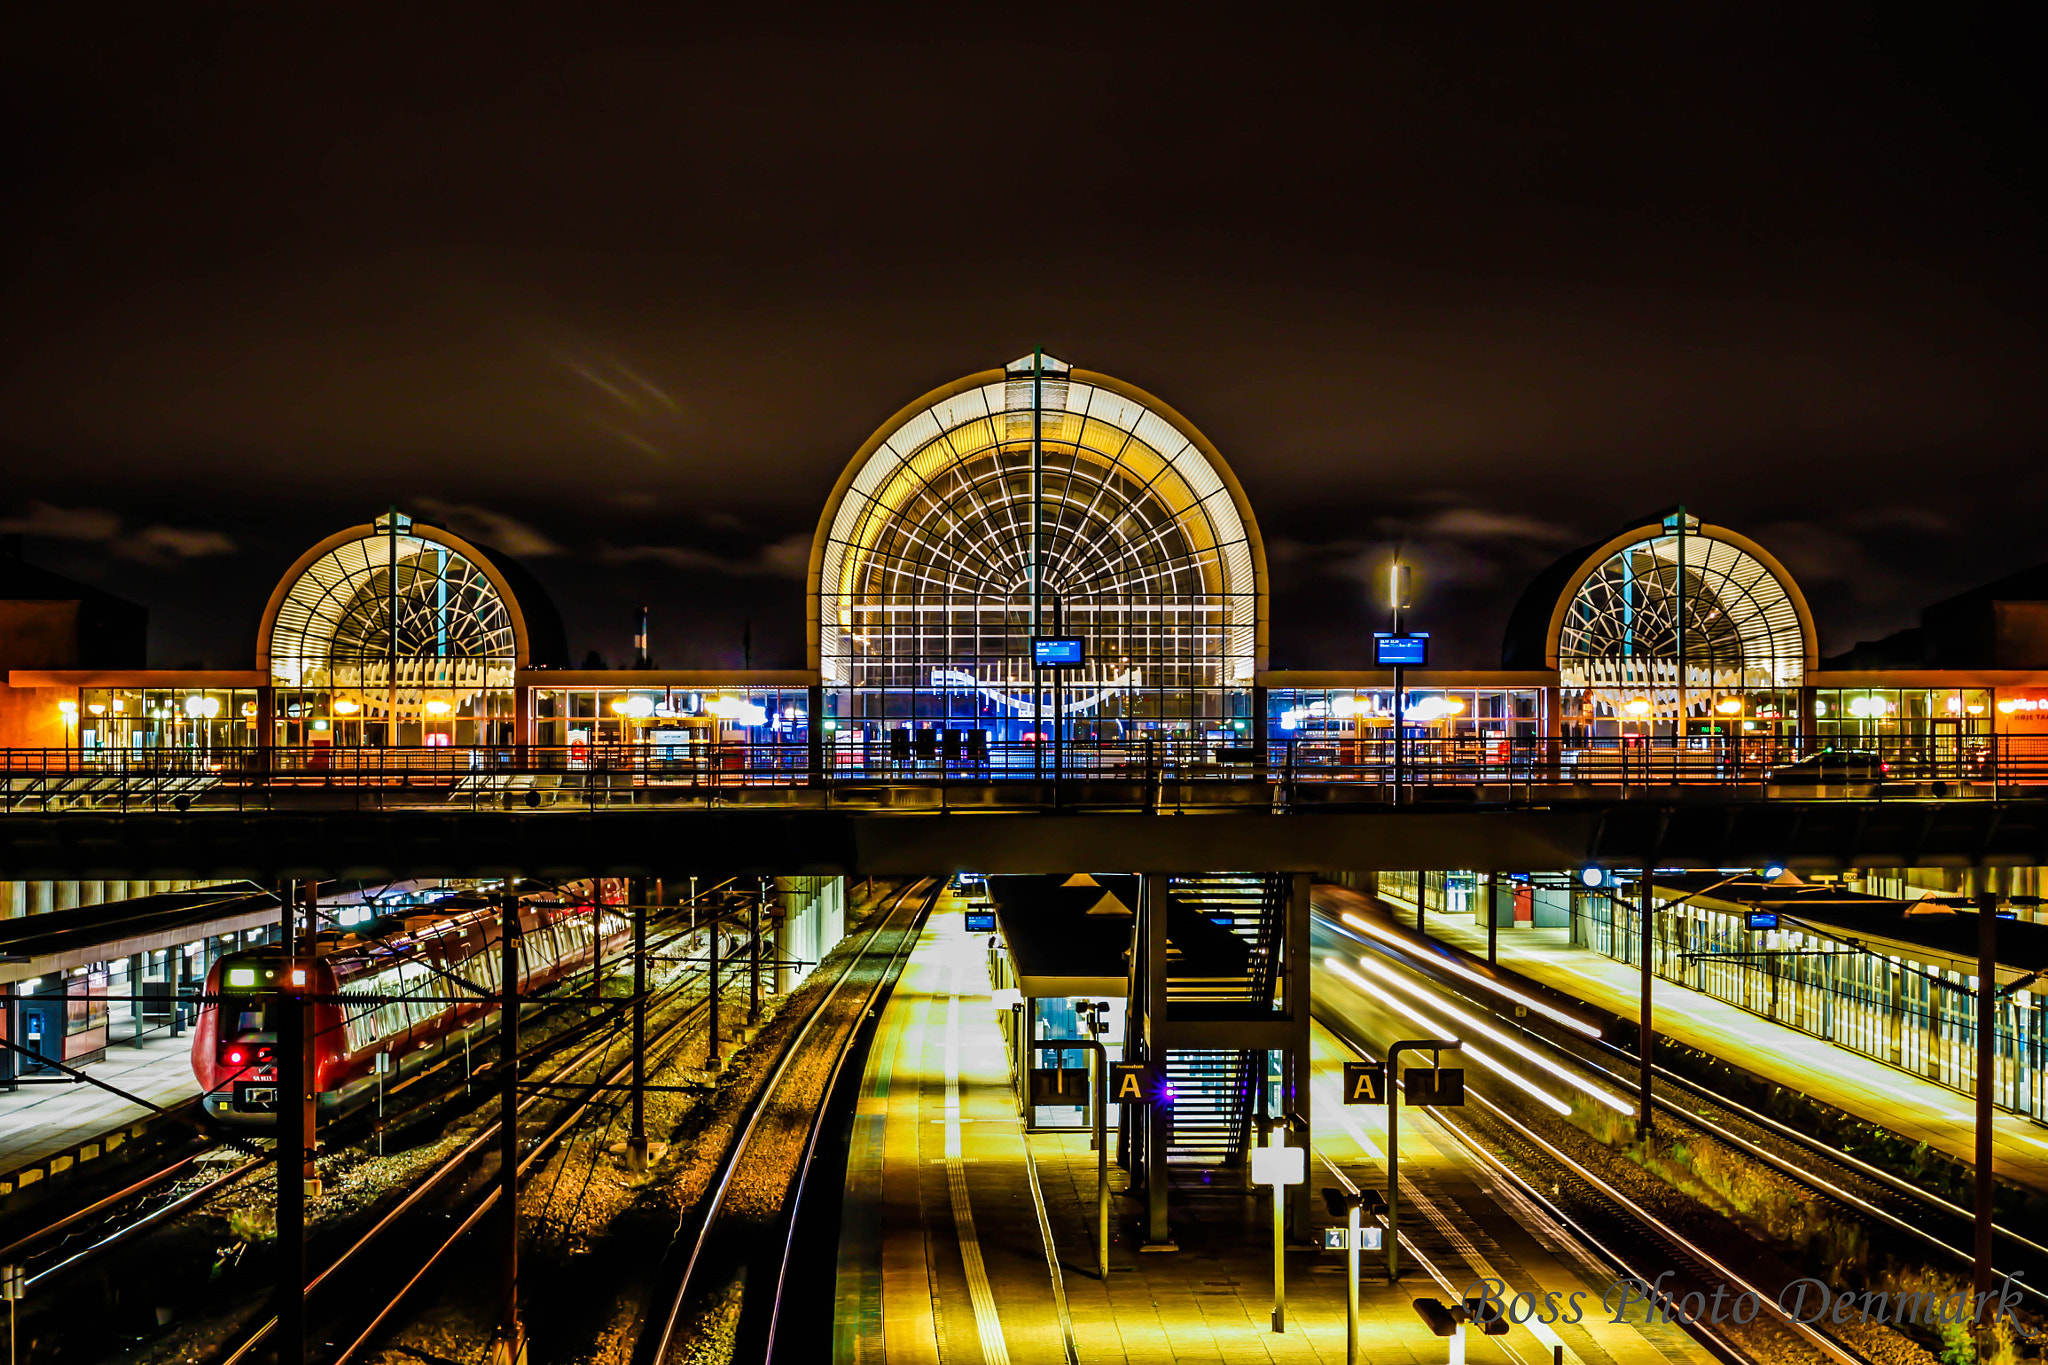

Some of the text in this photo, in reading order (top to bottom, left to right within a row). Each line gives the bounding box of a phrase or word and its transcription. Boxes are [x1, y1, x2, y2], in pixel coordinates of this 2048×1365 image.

[1119, 1074, 1141, 1098] A
[1353, 1075, 1376, 1099] A
[1330, 1234, 1340, 1247] 4
